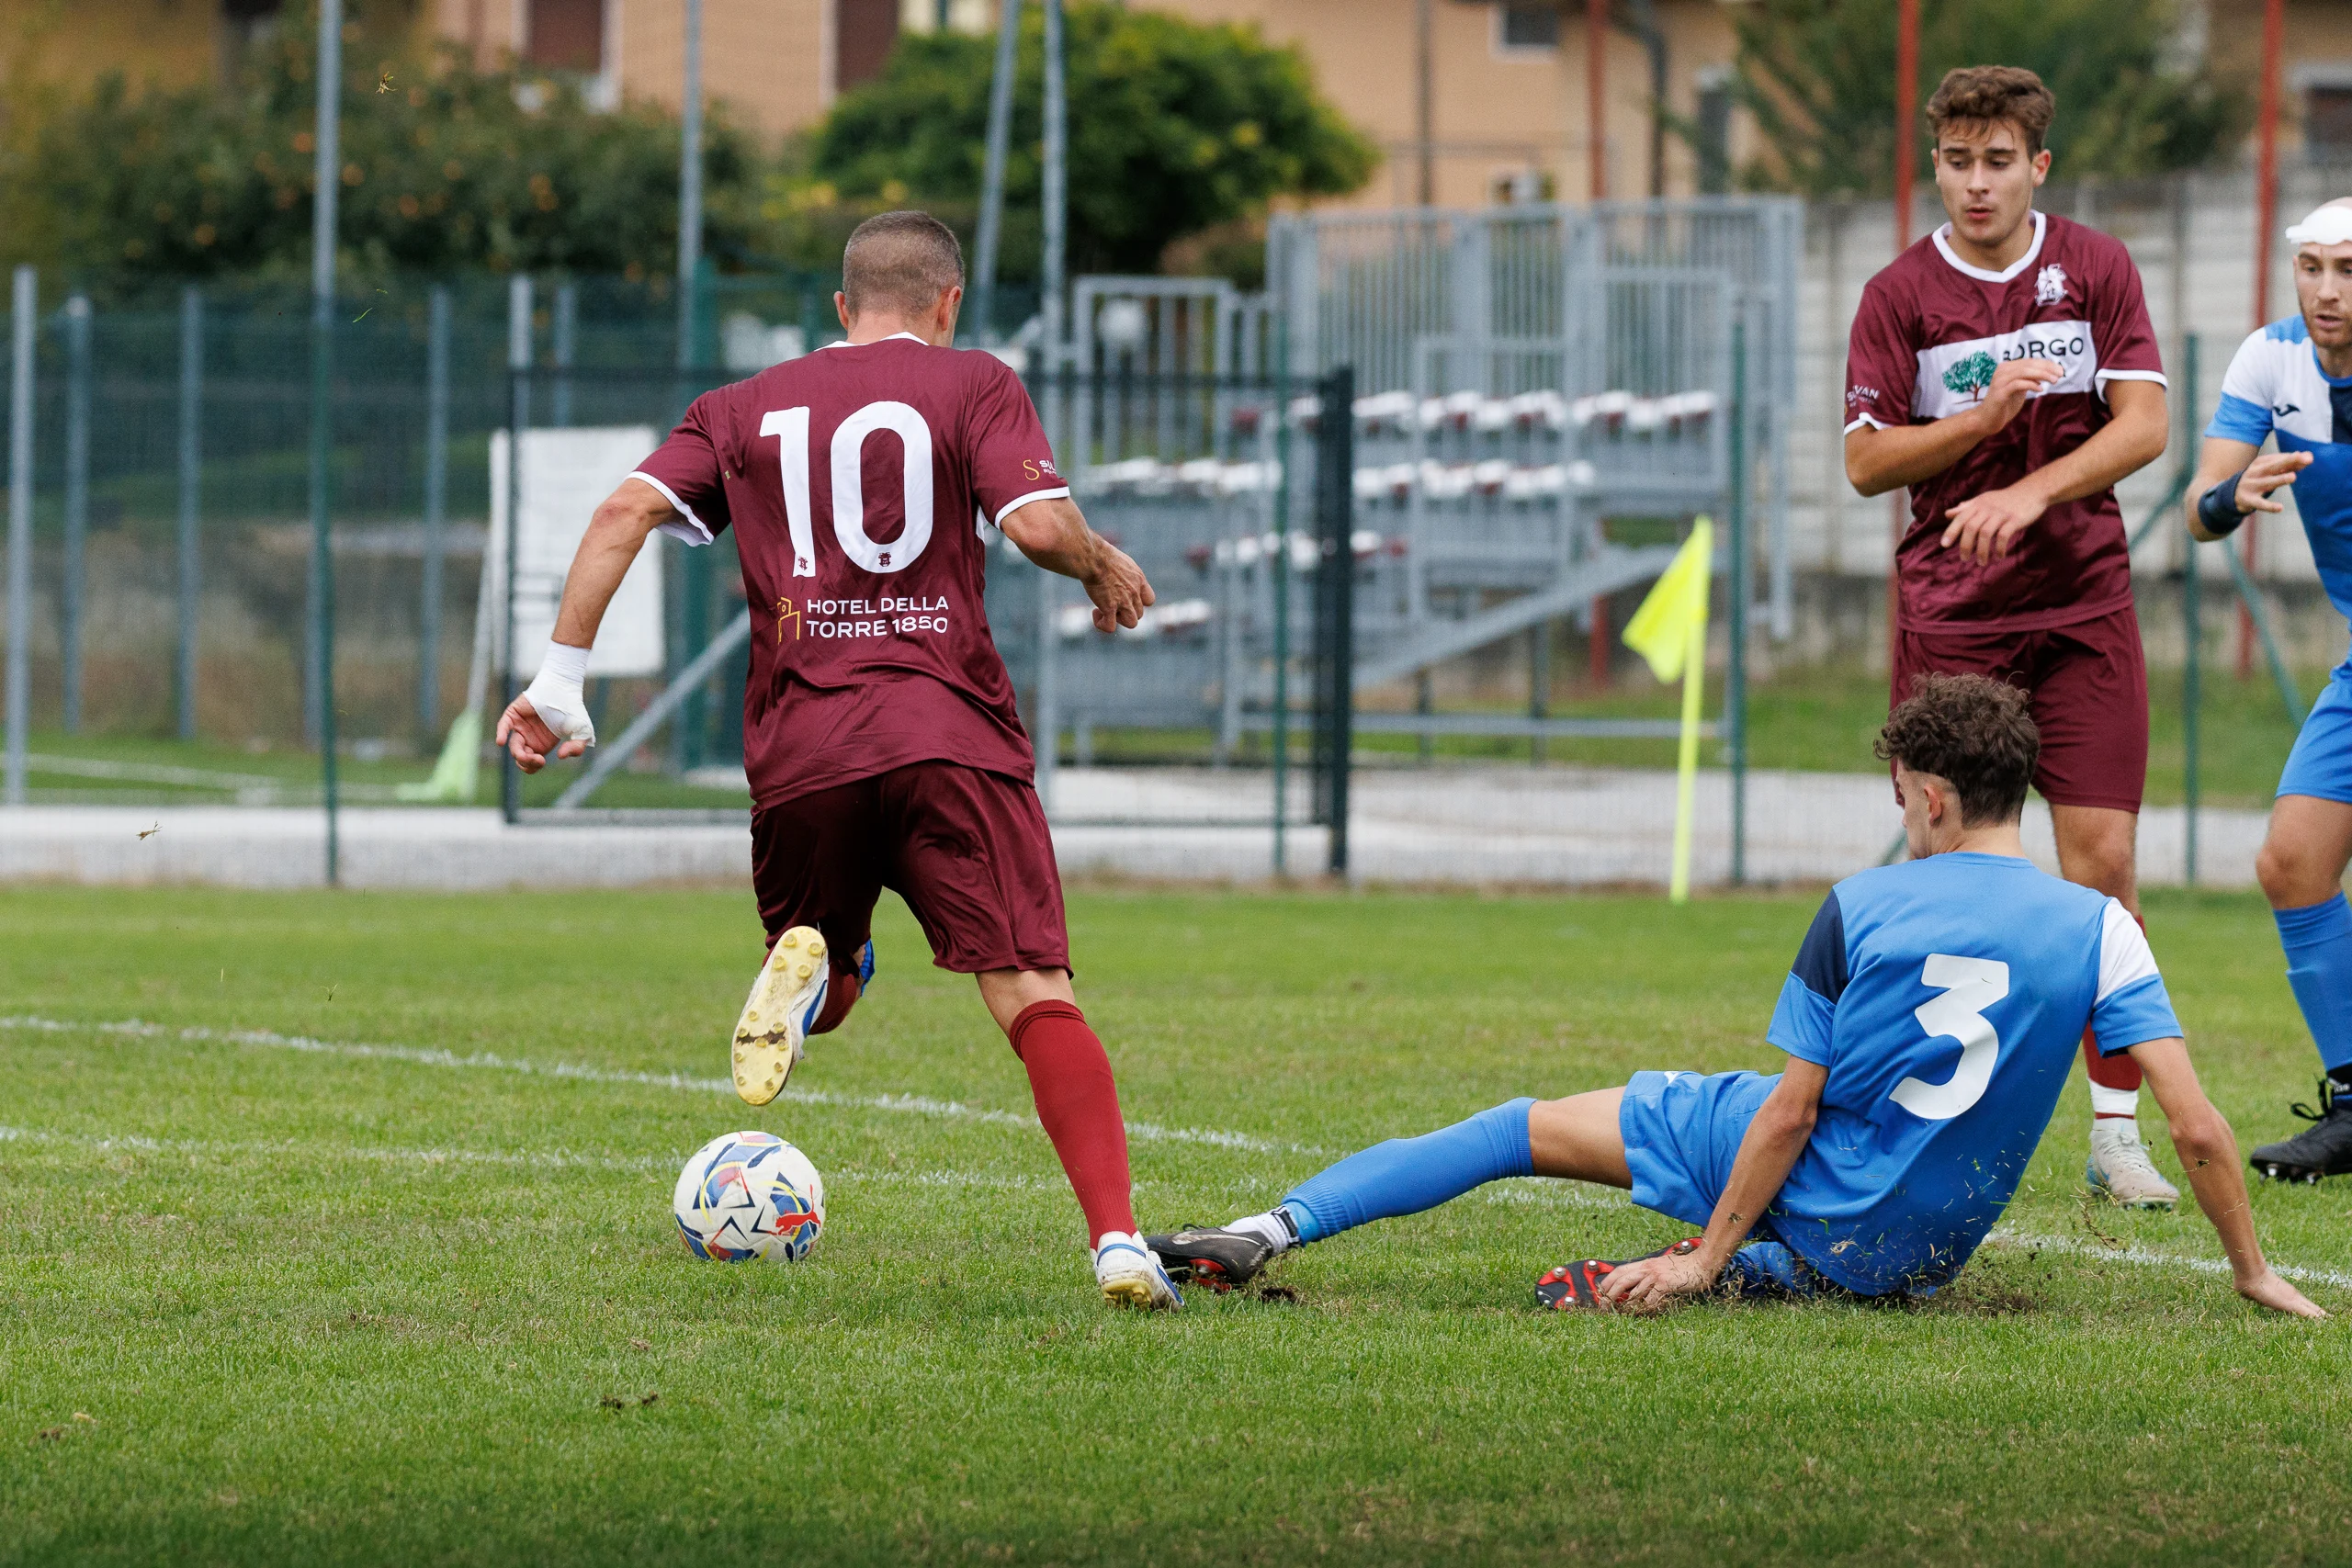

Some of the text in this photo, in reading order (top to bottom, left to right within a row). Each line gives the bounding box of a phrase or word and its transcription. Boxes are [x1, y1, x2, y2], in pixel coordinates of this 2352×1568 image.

[759, 400, 933, 577] 10
[806, 615, 948, 638] TORRE 1850
[807, 596, 949, 615] HOTEL DELLA
[1888, 953, 2009, 1120] 3
